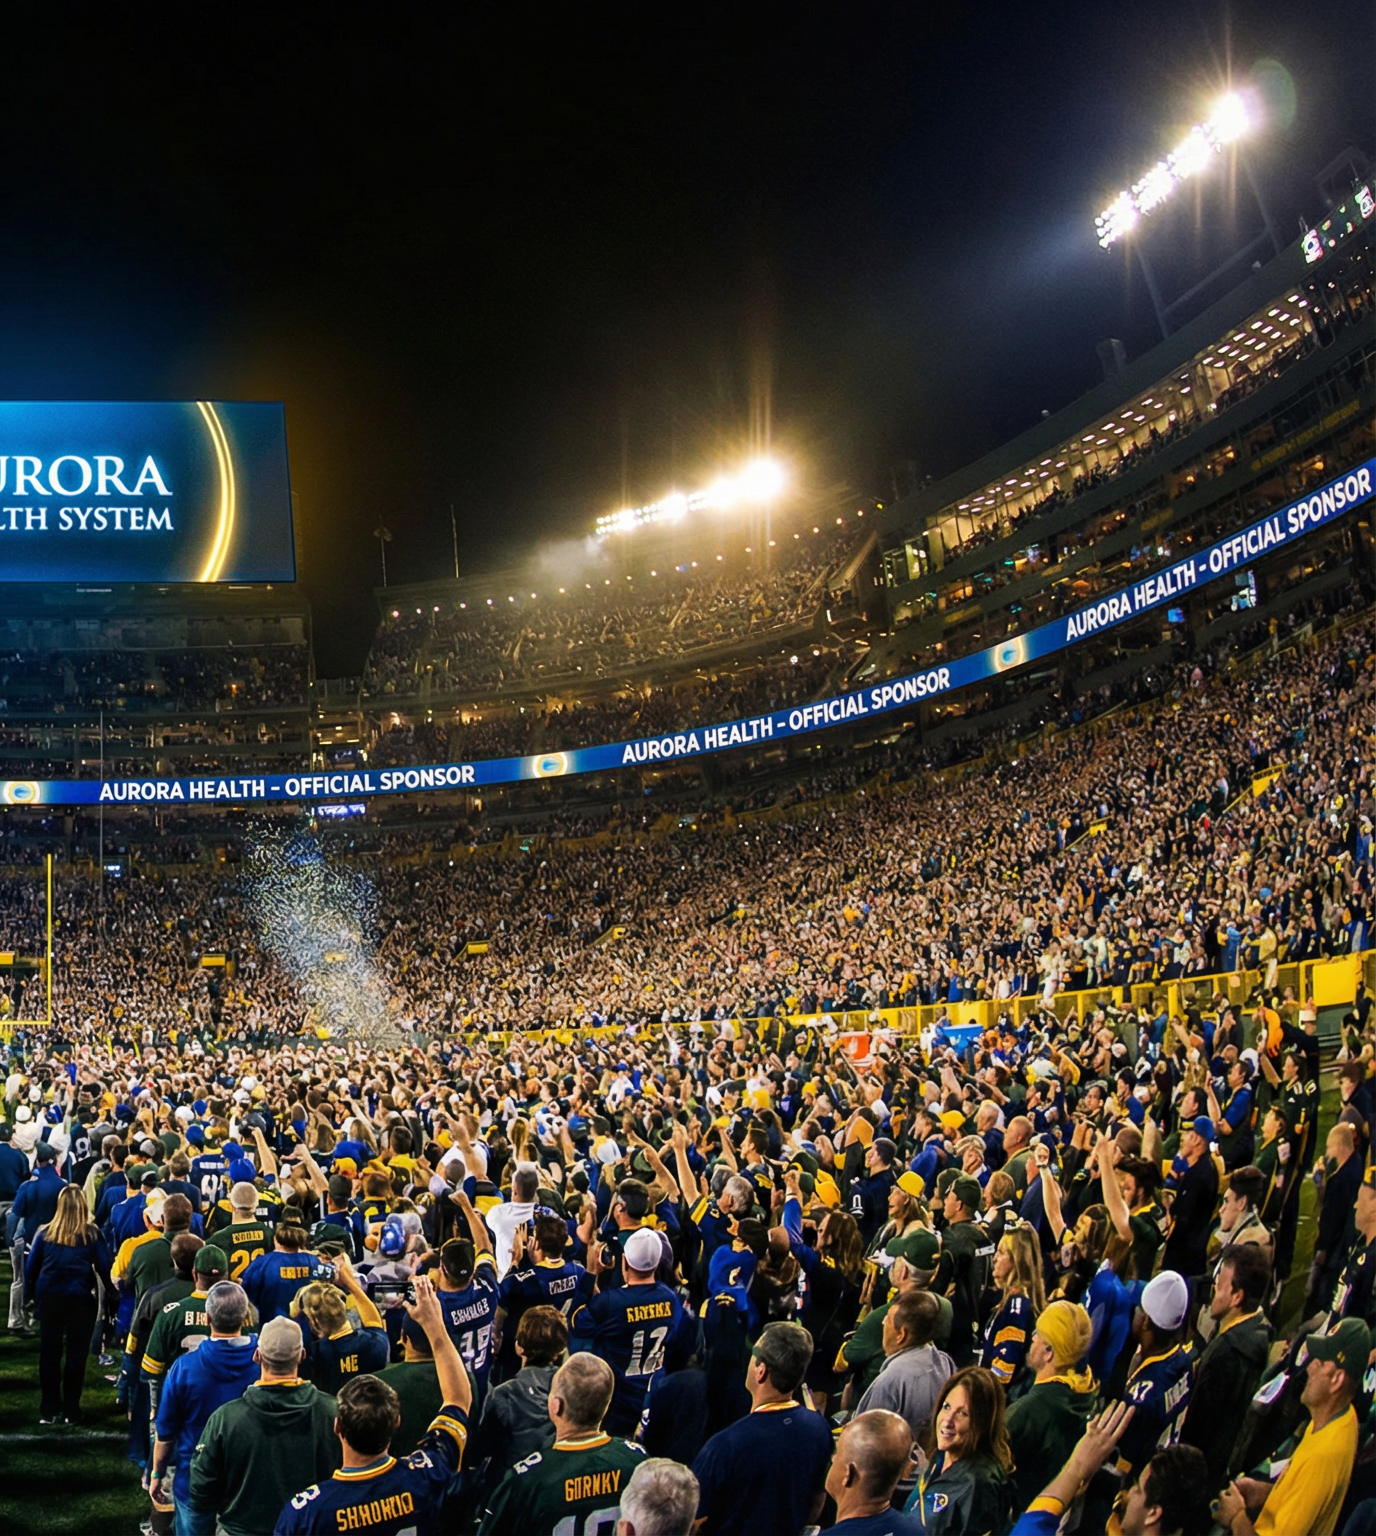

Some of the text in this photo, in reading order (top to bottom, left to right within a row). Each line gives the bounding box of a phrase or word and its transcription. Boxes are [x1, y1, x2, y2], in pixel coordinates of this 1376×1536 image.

[59, 507, 174, 531] SYSTEM
[1066, 592, 1133, 642] AURORA
[1134, 559, 1196, 610] HEALTH
[1209, 517, 1286, 573] OFFICIAL
[1287, 469, 1373, 534] SPONSOR
[622, 732, 701, 764] AURORA
[704, 716, 773, 750] HEALTH
[788, 693, 869, 731] OFFICIAL
[870, 667, 951, 710] SPONSOR
[99, 781, 185, 801] AURORA
[189, 779, 265, 799] HEALTH
[284, 773, 376, 796] OFFICIAL
[379, 765, 475, 791] SPONSOR
